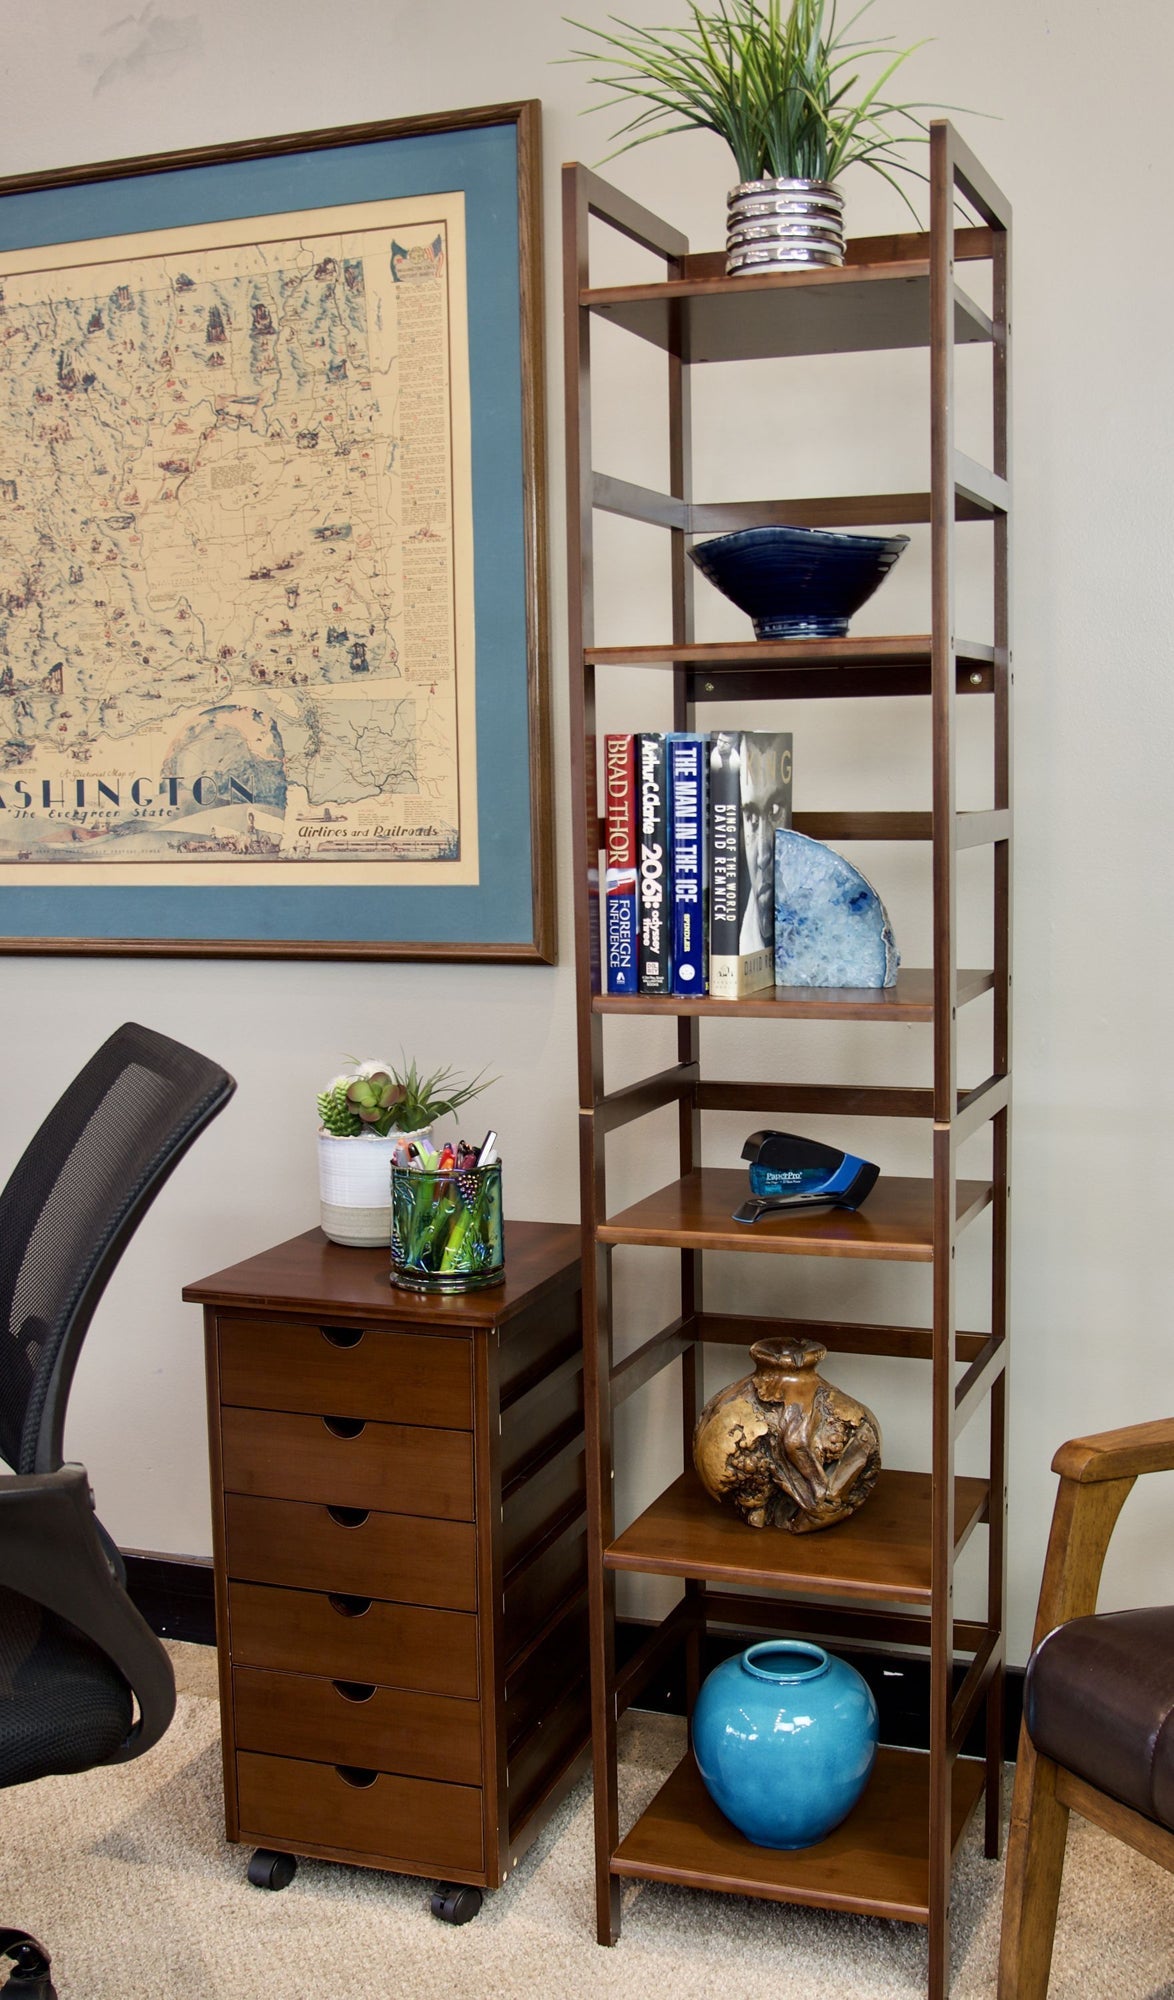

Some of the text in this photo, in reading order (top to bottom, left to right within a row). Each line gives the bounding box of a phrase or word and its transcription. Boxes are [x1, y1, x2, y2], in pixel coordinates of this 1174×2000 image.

[0, 774, 254, 809] SHINGTON
[106, 768, 126, 778] Map
[127, 770, 136, 779] of
[641, 740, 660, 782] Arthur
[48, 809, 120, 824] Evergreen
[298, 825, 439, 838] Airlines and Railroads
[608, 740, 630, 864] BRAD THOR
[675, 747, 697, 902] THE MAN IN THE ICE
[714, 804, 727, 921] DAVID REMNICK
[727, 805, 736, 922] KING OF THE WORLD
[641, 843, 663, 954] 2061: odyssey
[643, 917, 652, 946] three
[609, 900, 620, 967] INFLUENCE
[619, 900, 631, 967] FOREIGN
